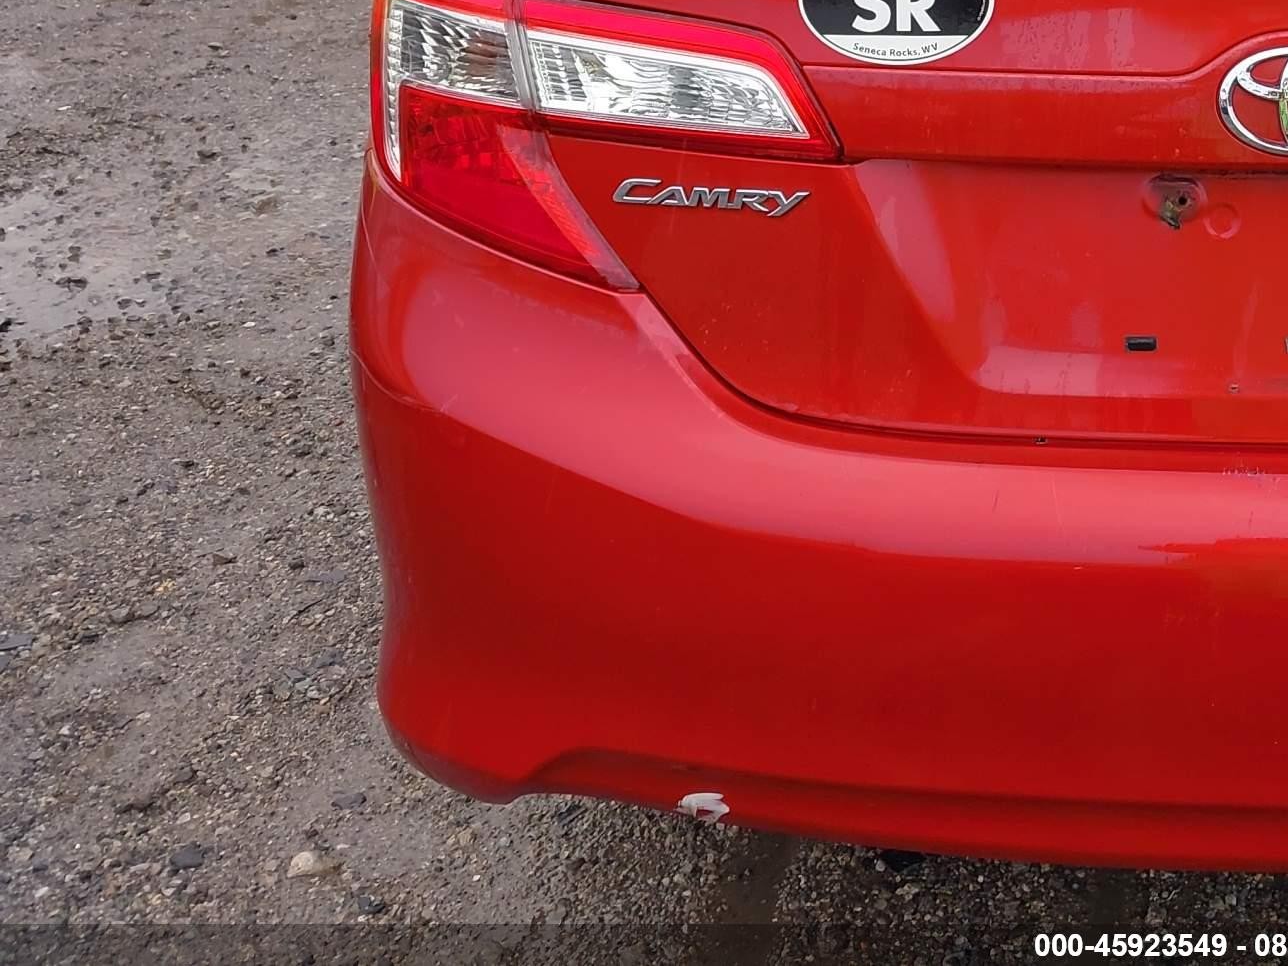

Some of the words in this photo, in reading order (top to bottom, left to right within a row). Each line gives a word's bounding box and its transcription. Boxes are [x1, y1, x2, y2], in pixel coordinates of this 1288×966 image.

[853, 43, 887, 56] Seneca
[889, 48, 921, 57] Rocks,
[921, 42, 938, 54] WV
[613, 178, 810, 216] CAMRY
